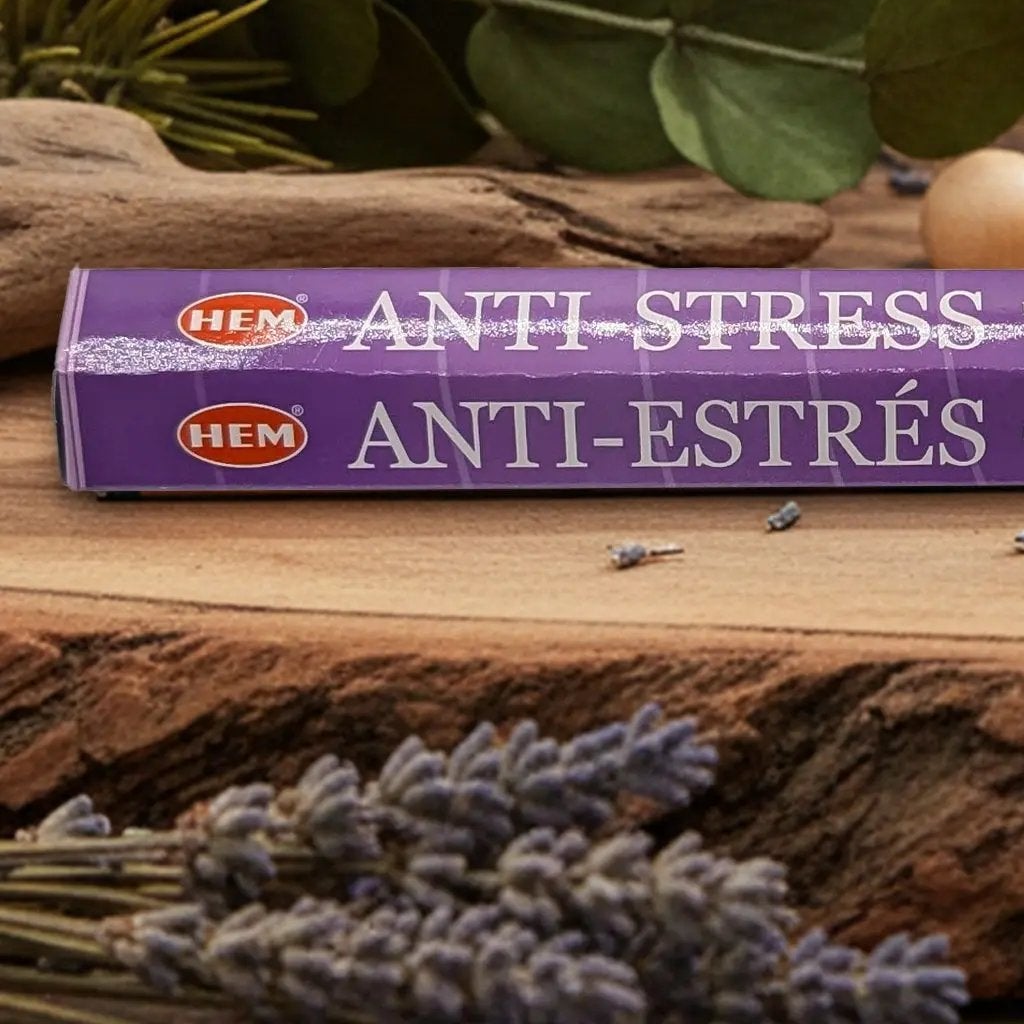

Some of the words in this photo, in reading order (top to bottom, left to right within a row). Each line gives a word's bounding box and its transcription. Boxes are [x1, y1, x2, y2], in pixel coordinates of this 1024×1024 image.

[189, 309, 297, 332] HEM
[342, 290, 591, 352] ANTI
[633, 289, 985, 352] STRESS
[189, 423, 296, 449] HEM
[347, 378, 987, 469] ANTI-ESTRÉS
